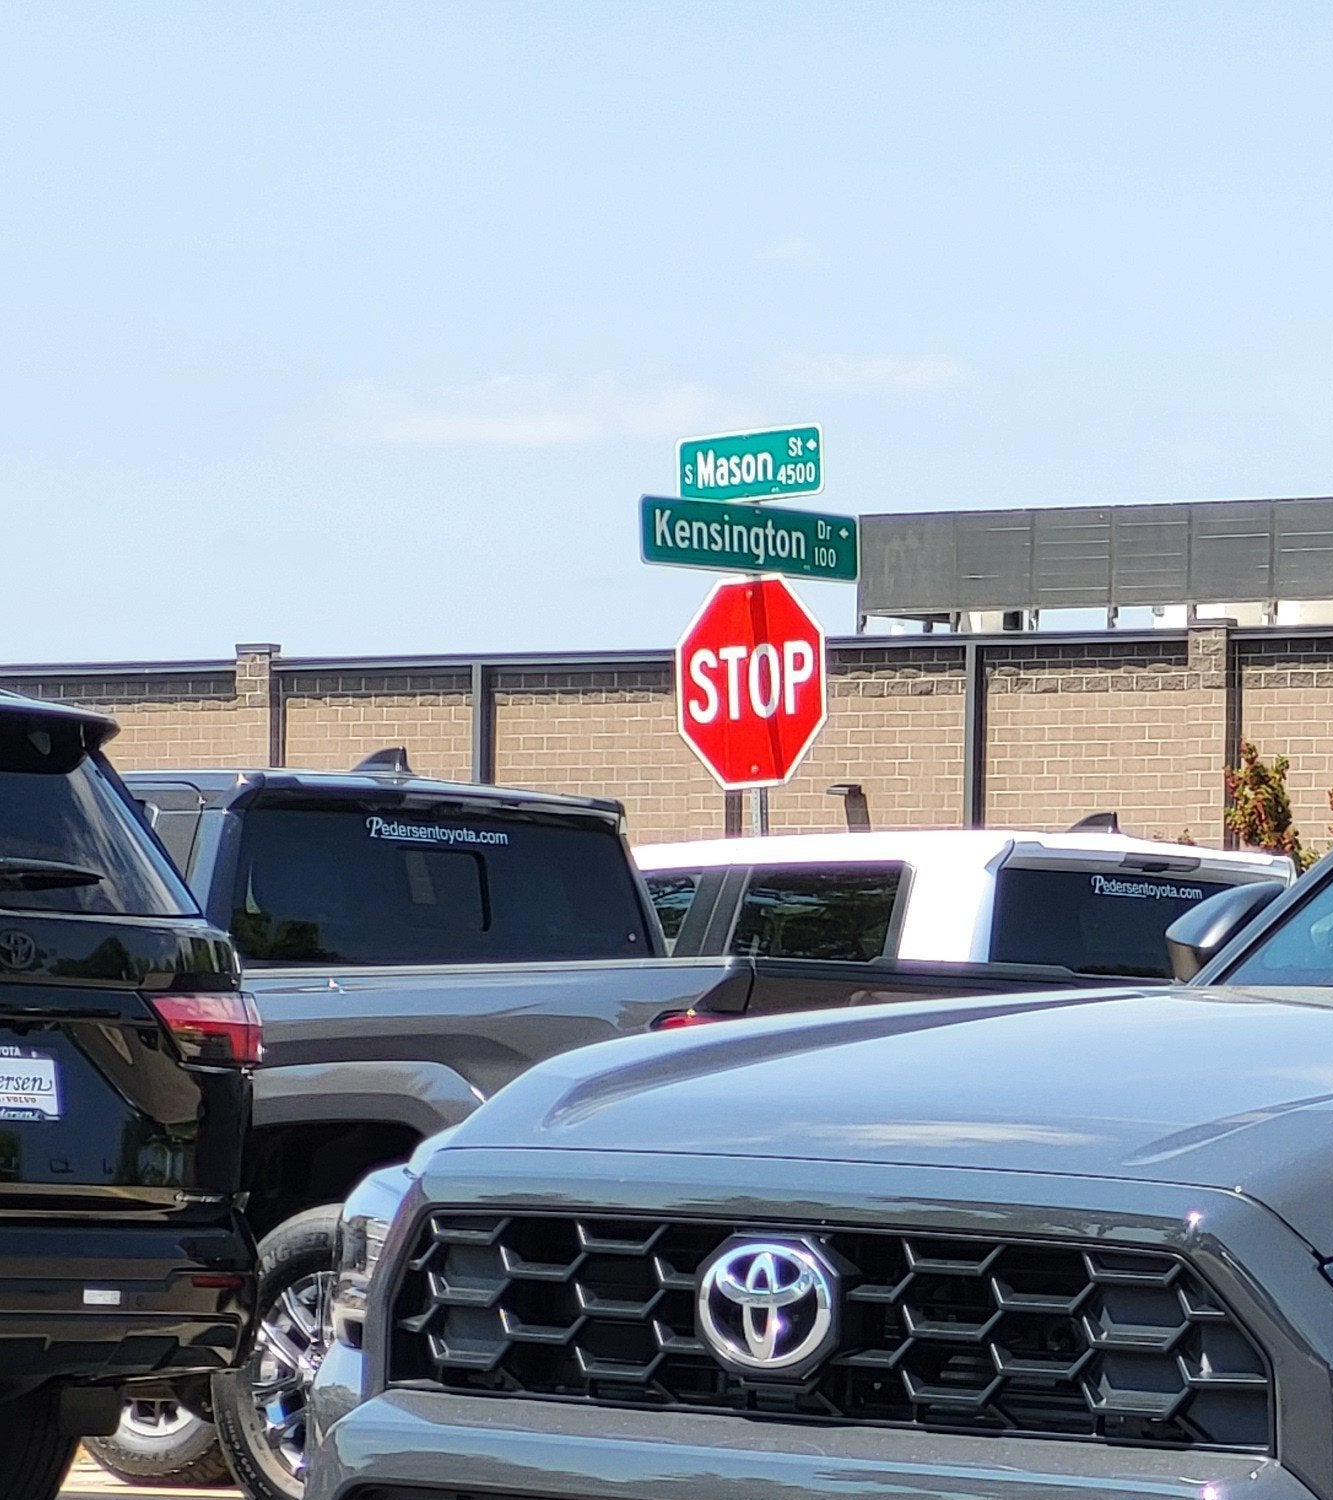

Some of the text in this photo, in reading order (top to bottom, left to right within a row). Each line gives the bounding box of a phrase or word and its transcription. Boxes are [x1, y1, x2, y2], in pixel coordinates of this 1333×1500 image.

[788, 436, 803, 457] St
[685, 450, 815, 489] S Mason 4500
[653, 508, 832, 564] Kensington Dr
[814, 546, 837, 568] 100
[688, 640, 814, 724] STOP
[366, 816, 508, 845] Pedersentoyota.com
[1091, 875, 1202, 899] Pedersentoyota.com
